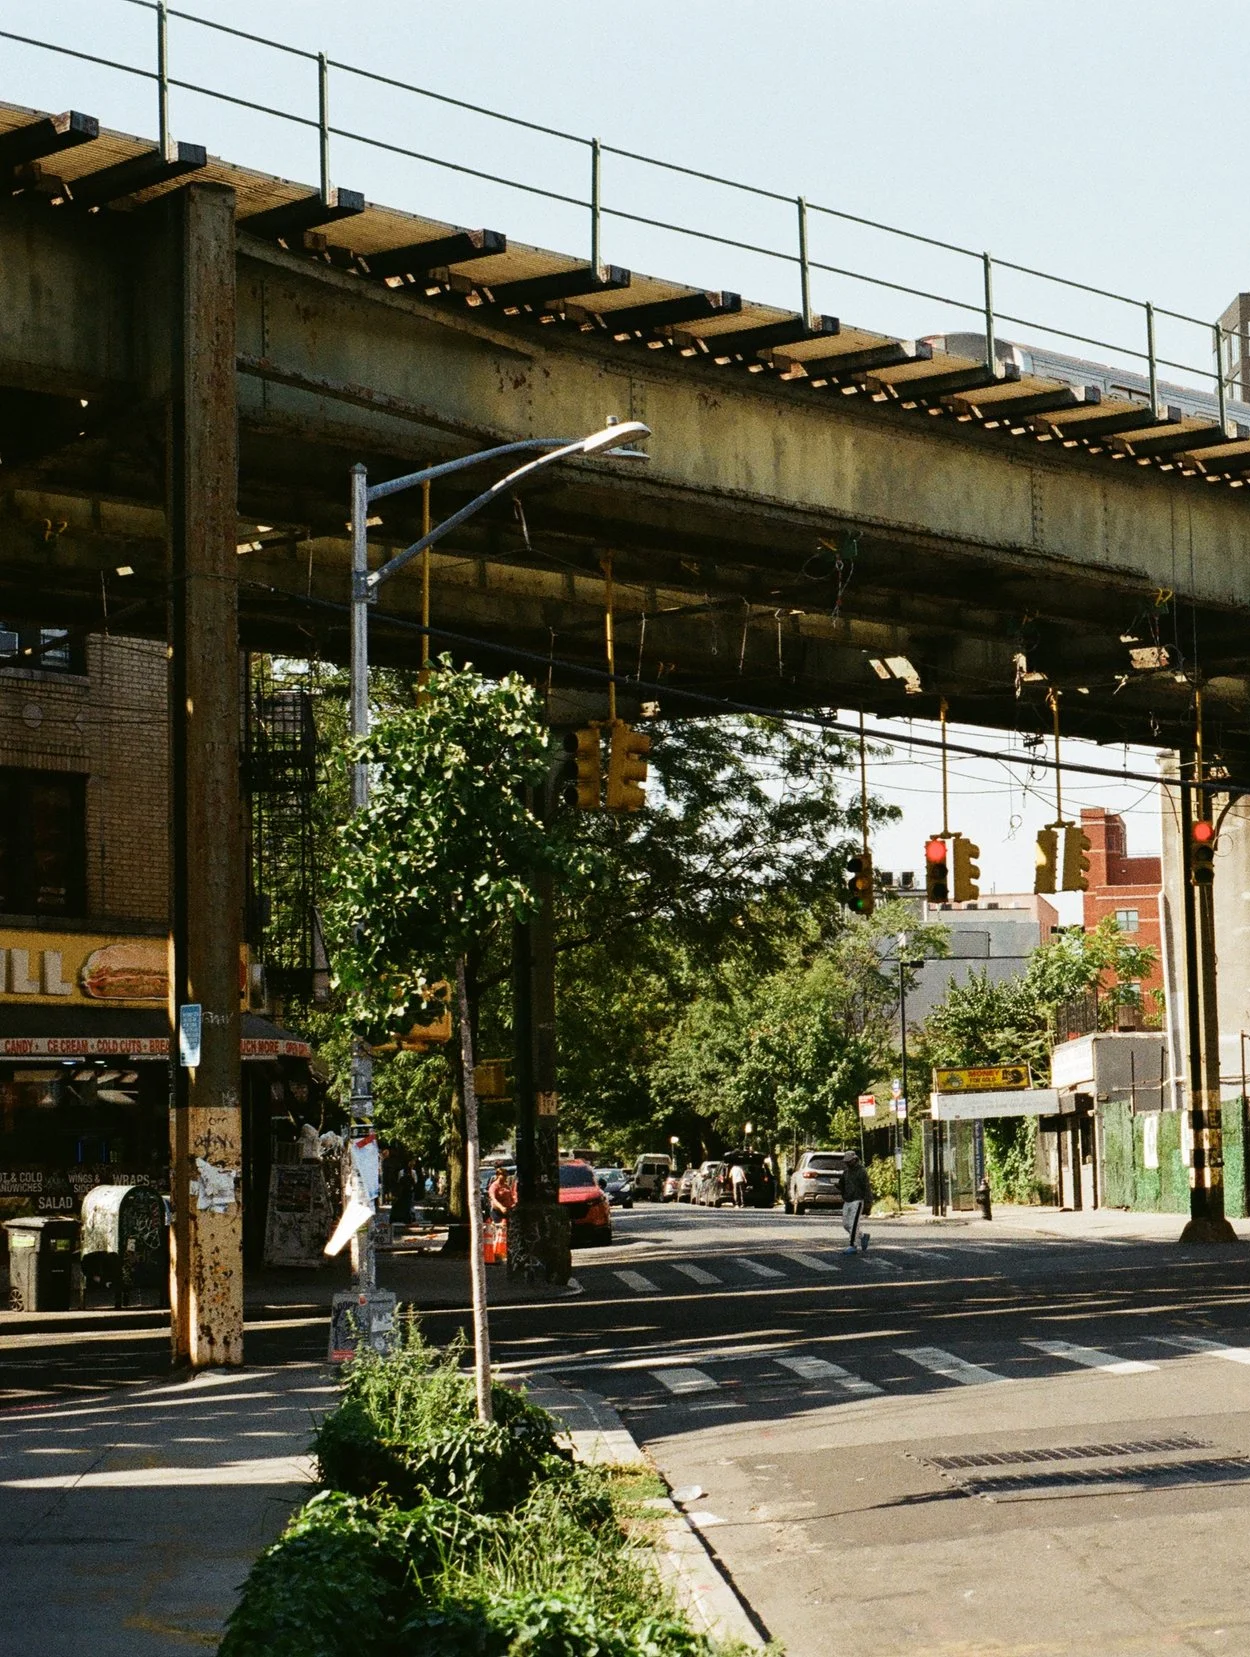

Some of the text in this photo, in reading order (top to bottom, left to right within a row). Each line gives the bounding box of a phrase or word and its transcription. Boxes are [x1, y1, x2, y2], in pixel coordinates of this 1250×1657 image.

[5, 1040, 33, 1053] CANDY
[60, 1040, 89, 1053] CREAM
[97, 1040, 119, 1053] COLD
[120, 1040, 142, 1053] CUTS
[19, 1172, 43, 1182] COLD
[68, 1174, 93, 1184] WINGS
[113, 1174, 150, 1186] WRAPS
[0, 1183, 43, 1193] NDWICHES
[38, 1196, 73, 1210] SALAD
